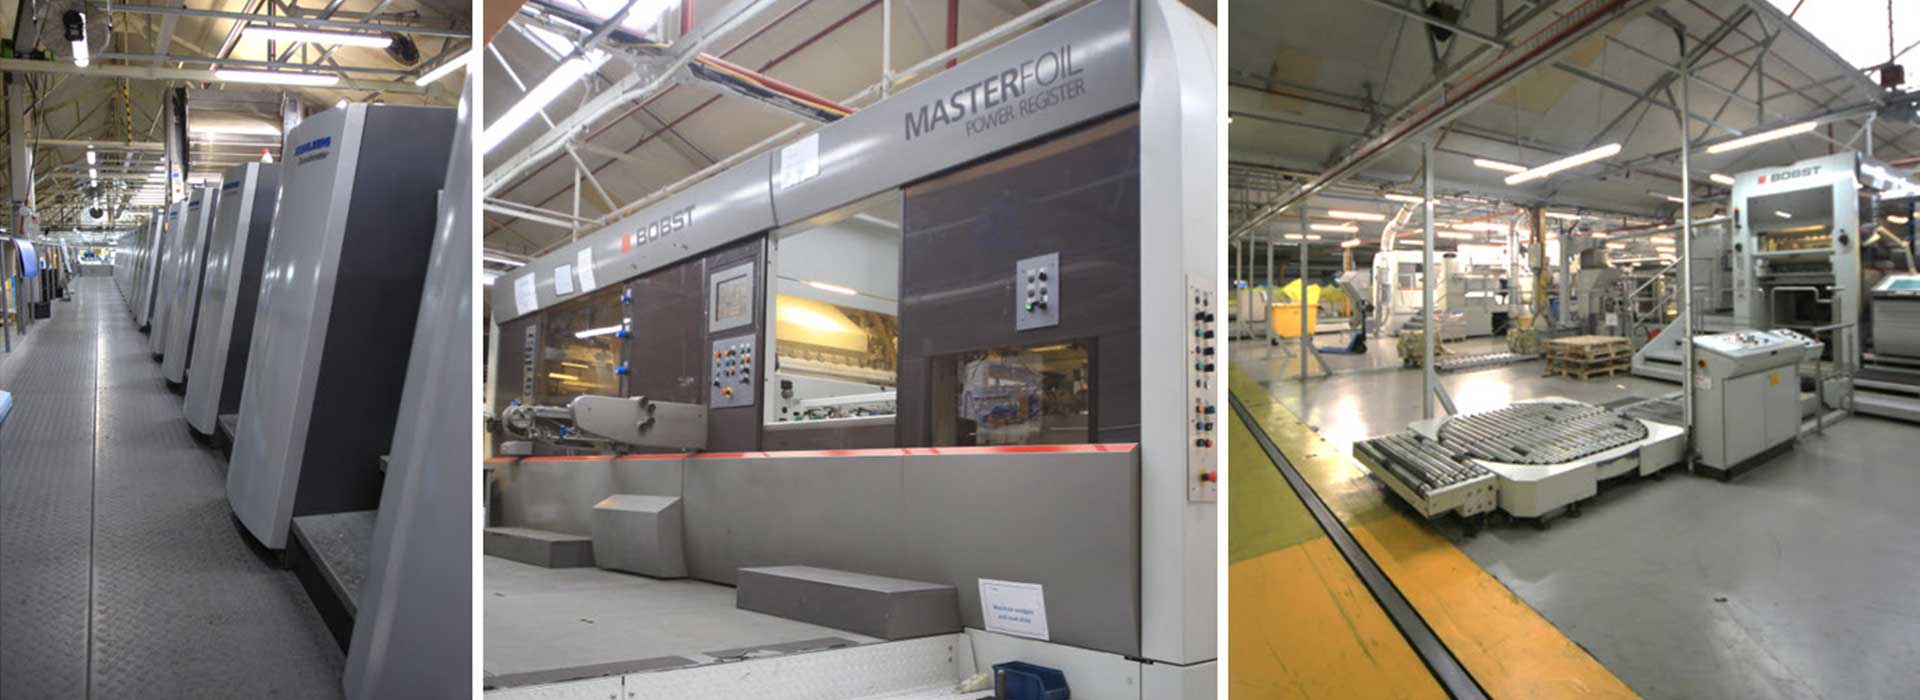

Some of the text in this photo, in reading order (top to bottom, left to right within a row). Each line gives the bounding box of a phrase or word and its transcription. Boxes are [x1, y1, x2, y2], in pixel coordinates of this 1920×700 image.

[904, 44, 1084, 140] MASTERFOIL
[966, 79, 1086, 136] POWER REGISTER
[1770, 165, 1821, 182] BOBST
[636, 204, 696, 247] BOBST
